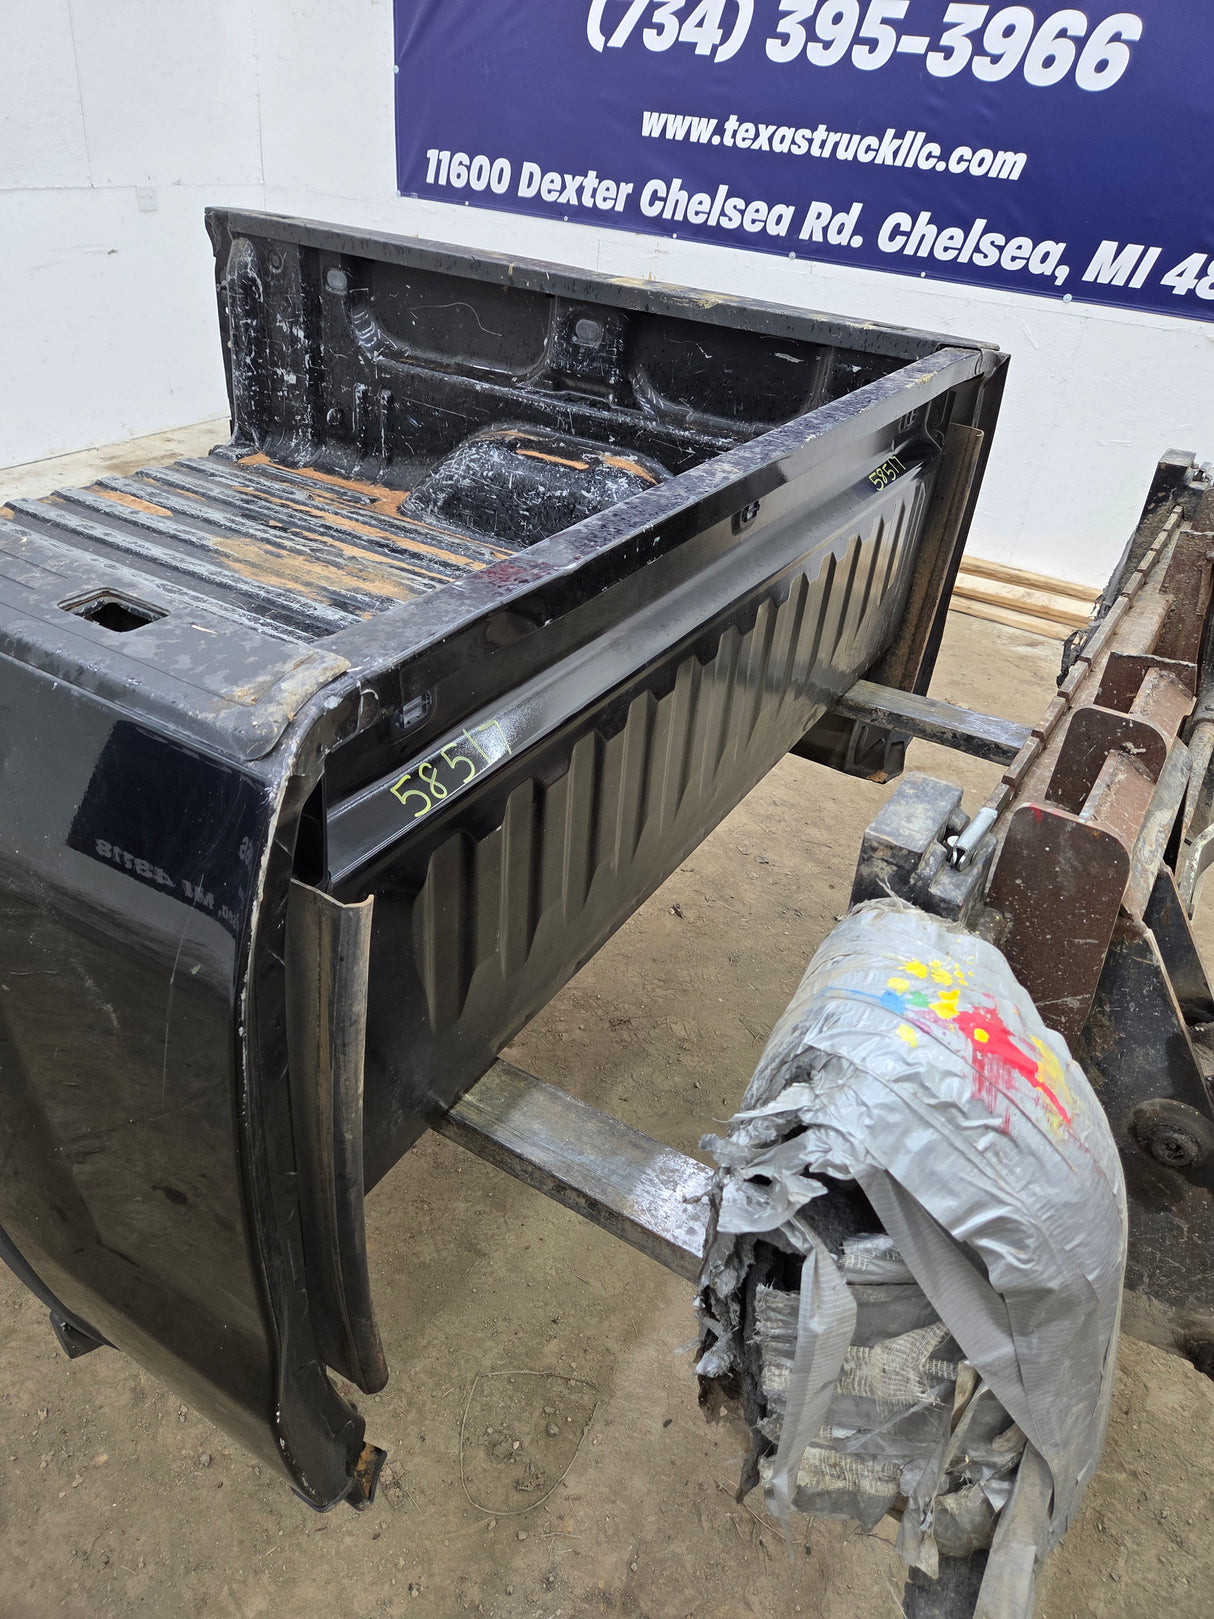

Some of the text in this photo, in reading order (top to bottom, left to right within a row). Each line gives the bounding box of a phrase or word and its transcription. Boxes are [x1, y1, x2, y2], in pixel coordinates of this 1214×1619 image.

[765, 0, 1143, 92] 395-3966
[641, 110, 1028, 181] www.texastruckllc.com
[425, 148, 512, 194] 11600
[517, 161, 634, 213] Dexter
[639, 177, 796, 237] Chelsea
[798, 200, 864, 248] Rd.
[877, 210, 1070, 286] Chelsea,
[1081, 240, 1163, 289] MI
[868, 455, 907, 491] 58517
[389, 719, 512, 818] 58517
